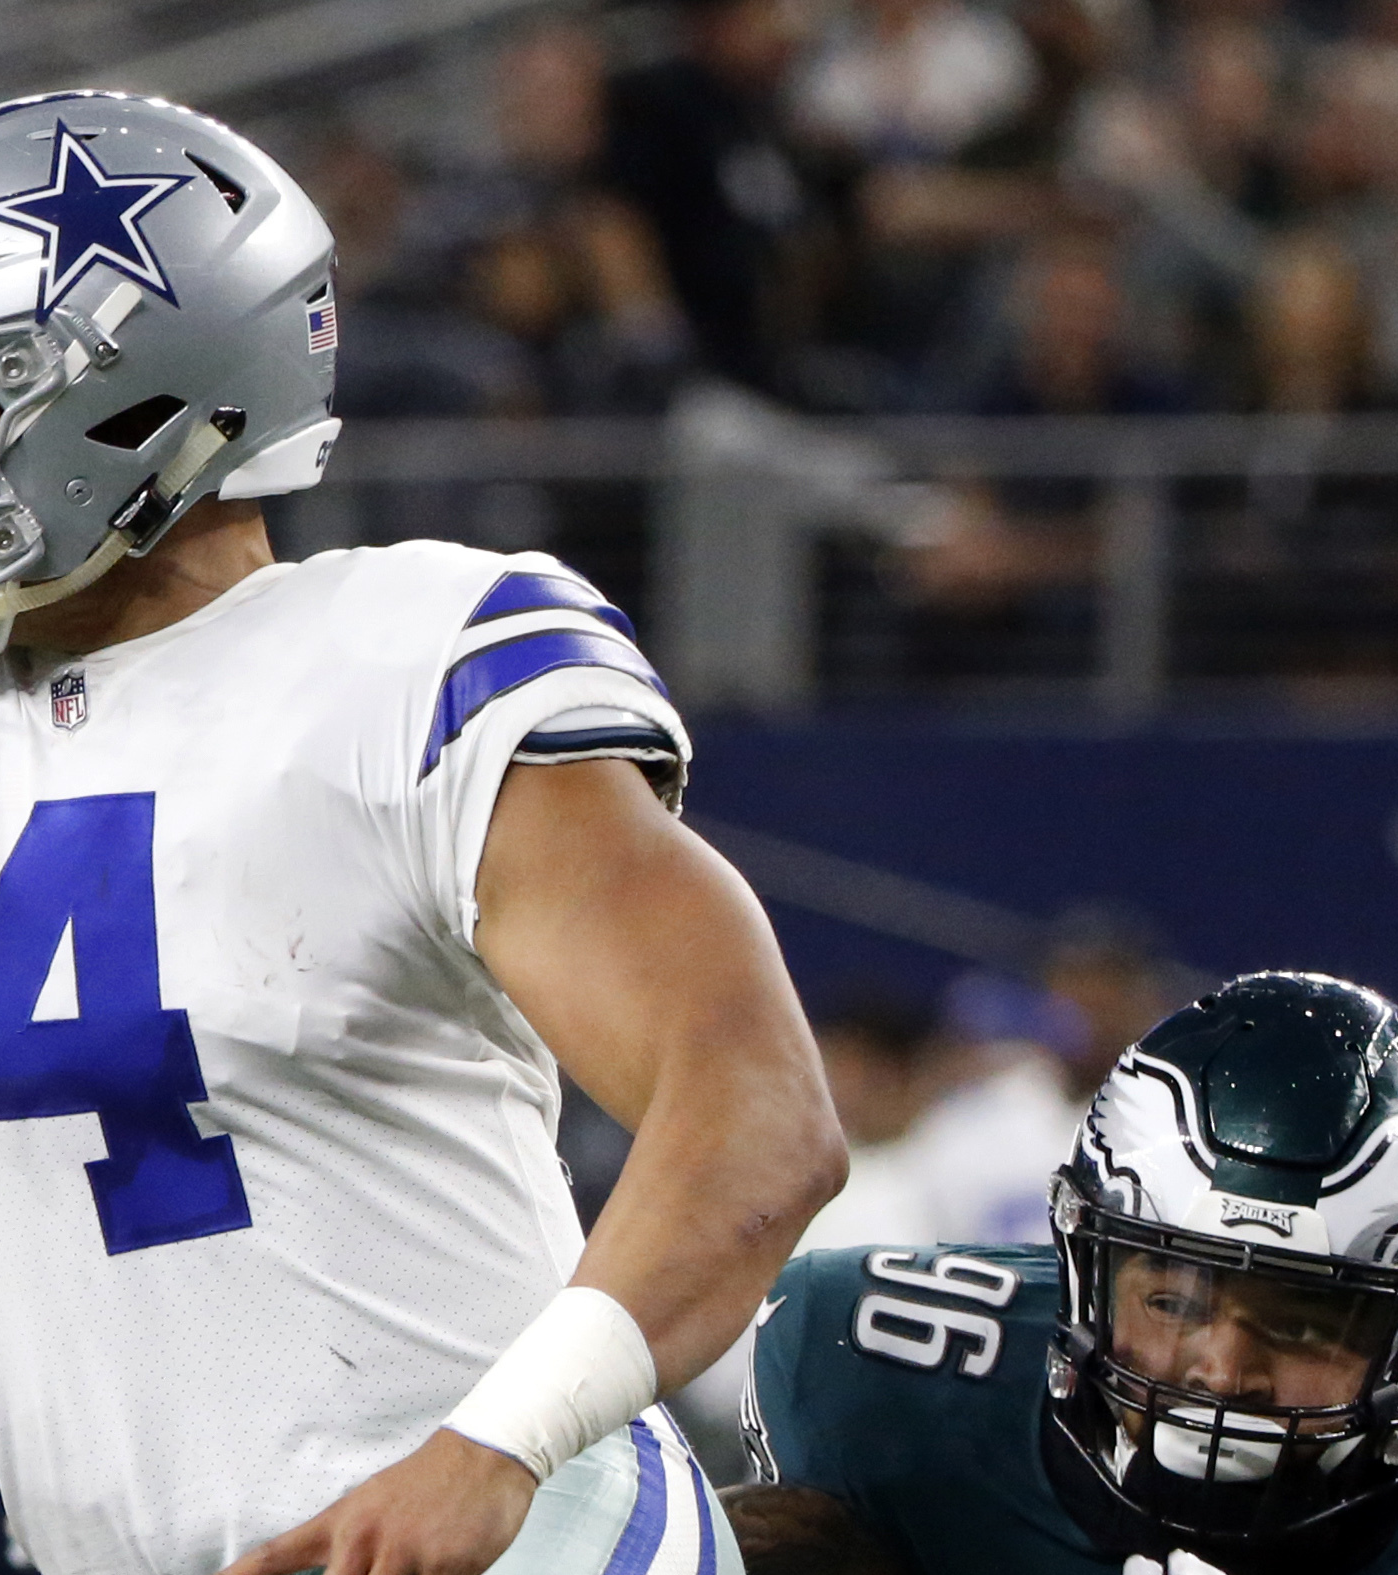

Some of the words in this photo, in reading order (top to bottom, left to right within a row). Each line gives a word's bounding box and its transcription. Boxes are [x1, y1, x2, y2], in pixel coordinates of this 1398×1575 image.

[53, 697, 84, 724] NFL
[1223, 1200, 1293, 1234] EAGLES
[854, 1250, 1019, 1378] 96
